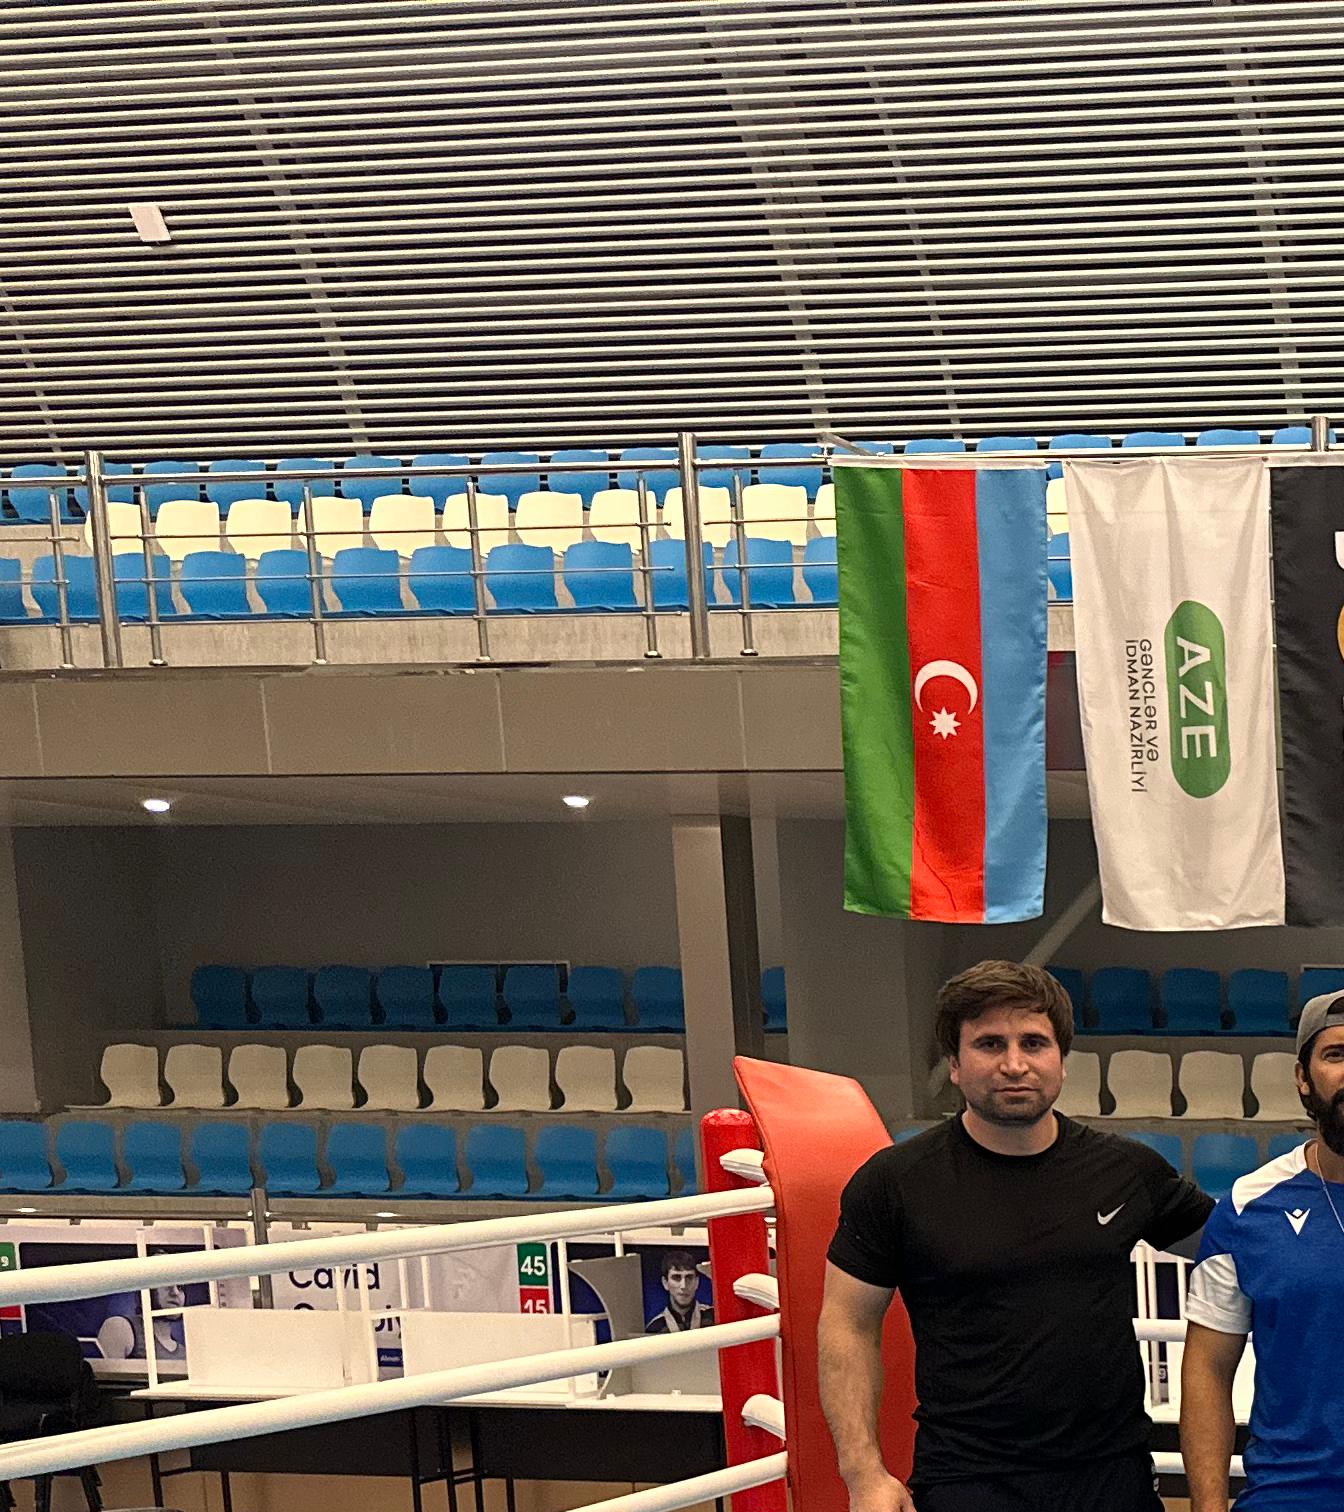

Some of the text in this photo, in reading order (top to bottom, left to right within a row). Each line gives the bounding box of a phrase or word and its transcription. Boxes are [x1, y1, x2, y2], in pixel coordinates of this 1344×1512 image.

[1139, 638, 1160, 762] GƏNCLƏR VƏ
[1176, 635, 1217, 759] AZE
[520, 1255, 546, 1276] 45
